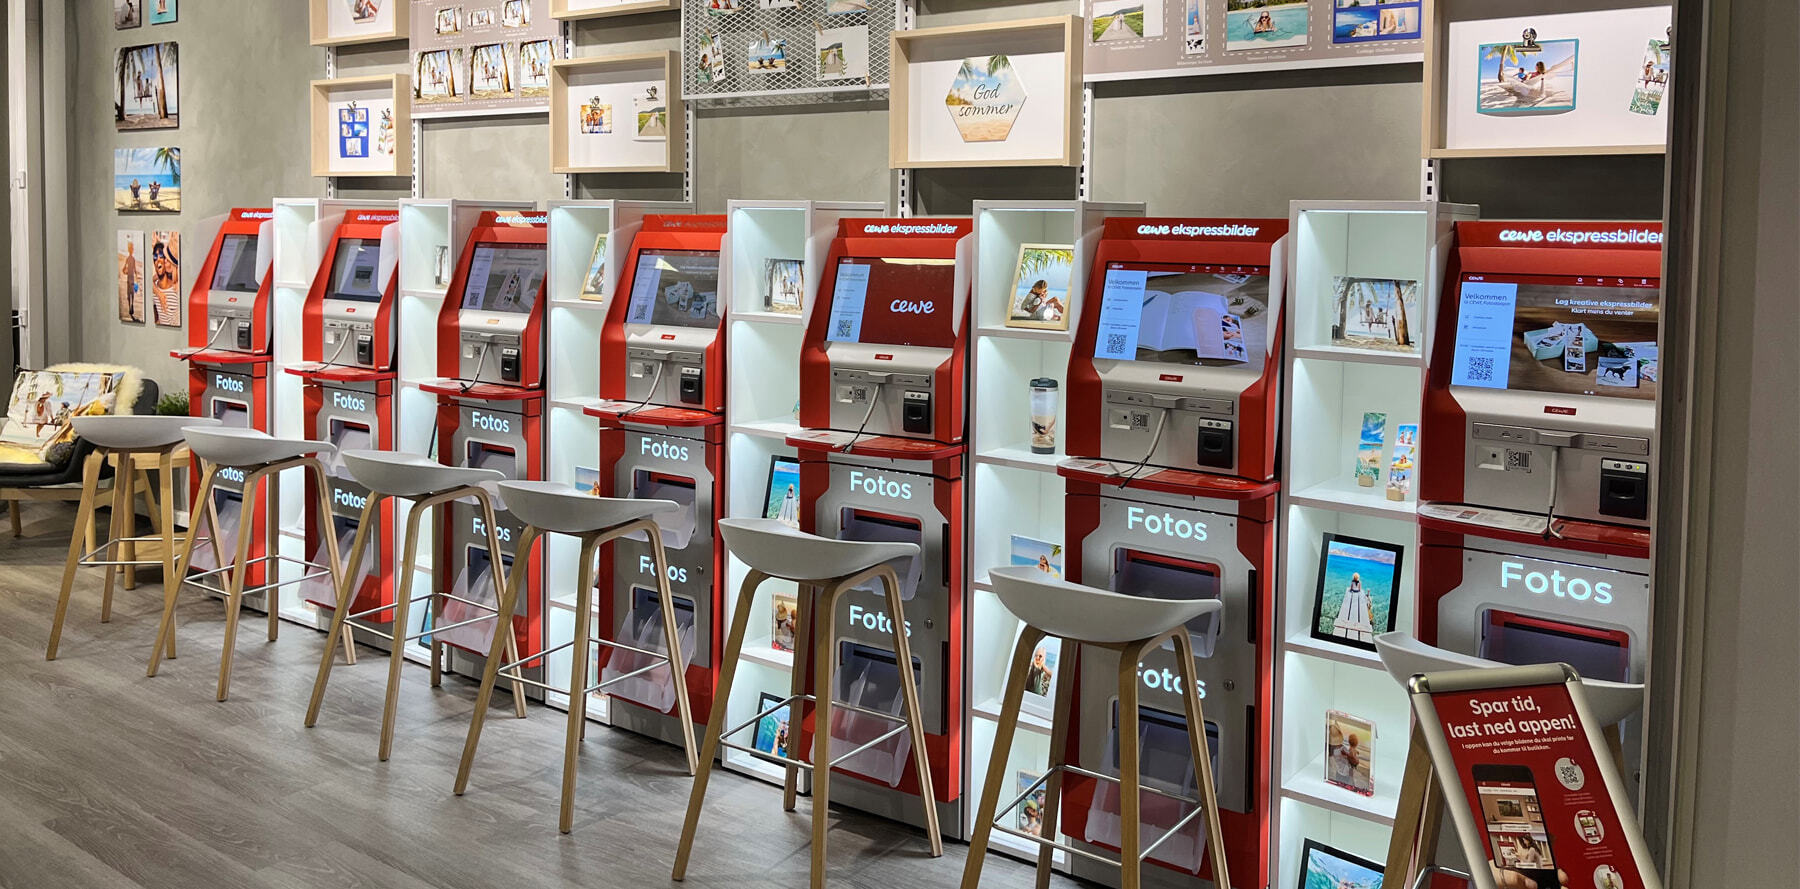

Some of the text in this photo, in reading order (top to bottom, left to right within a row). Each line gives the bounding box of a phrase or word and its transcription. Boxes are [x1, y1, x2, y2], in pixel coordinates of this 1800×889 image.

[973, 83, 1001, 100] God
[959, 104, 1013, 116] sommer
[864, 223, 958, 234] cewe ekspressbilder
[1137, 224, 1259, 237] cewe ekspressbilder
[1499, 229, 1544, 242] cewe
[890, 299, 935, 314] cewe
[1555, 298, 1569, 306] Lag
[1600, 300, 1653, 309] ekspressbilder
[216, 374, 244, 392] Fotos
[333, 392, 366, 411] Fotos
[472, 411, 510, 433] Fotos
[641, 437, 688, 461] Fotos
[850, 471, 912, 500] Fotos
[472, 518, 511, 542] Foos
[1127, 506, 1208, 542] Fotos
[640, 555, 688, 583] Foos
[1501, 561, 1613, 604] Fotos
[1469, 696, 1541, 718] Spar tid,
[1447, 714, 1576, 738] last ned appen!
[1466, 742, 1482, 750] appen
[1514, 738, 1534, 746] bildene
